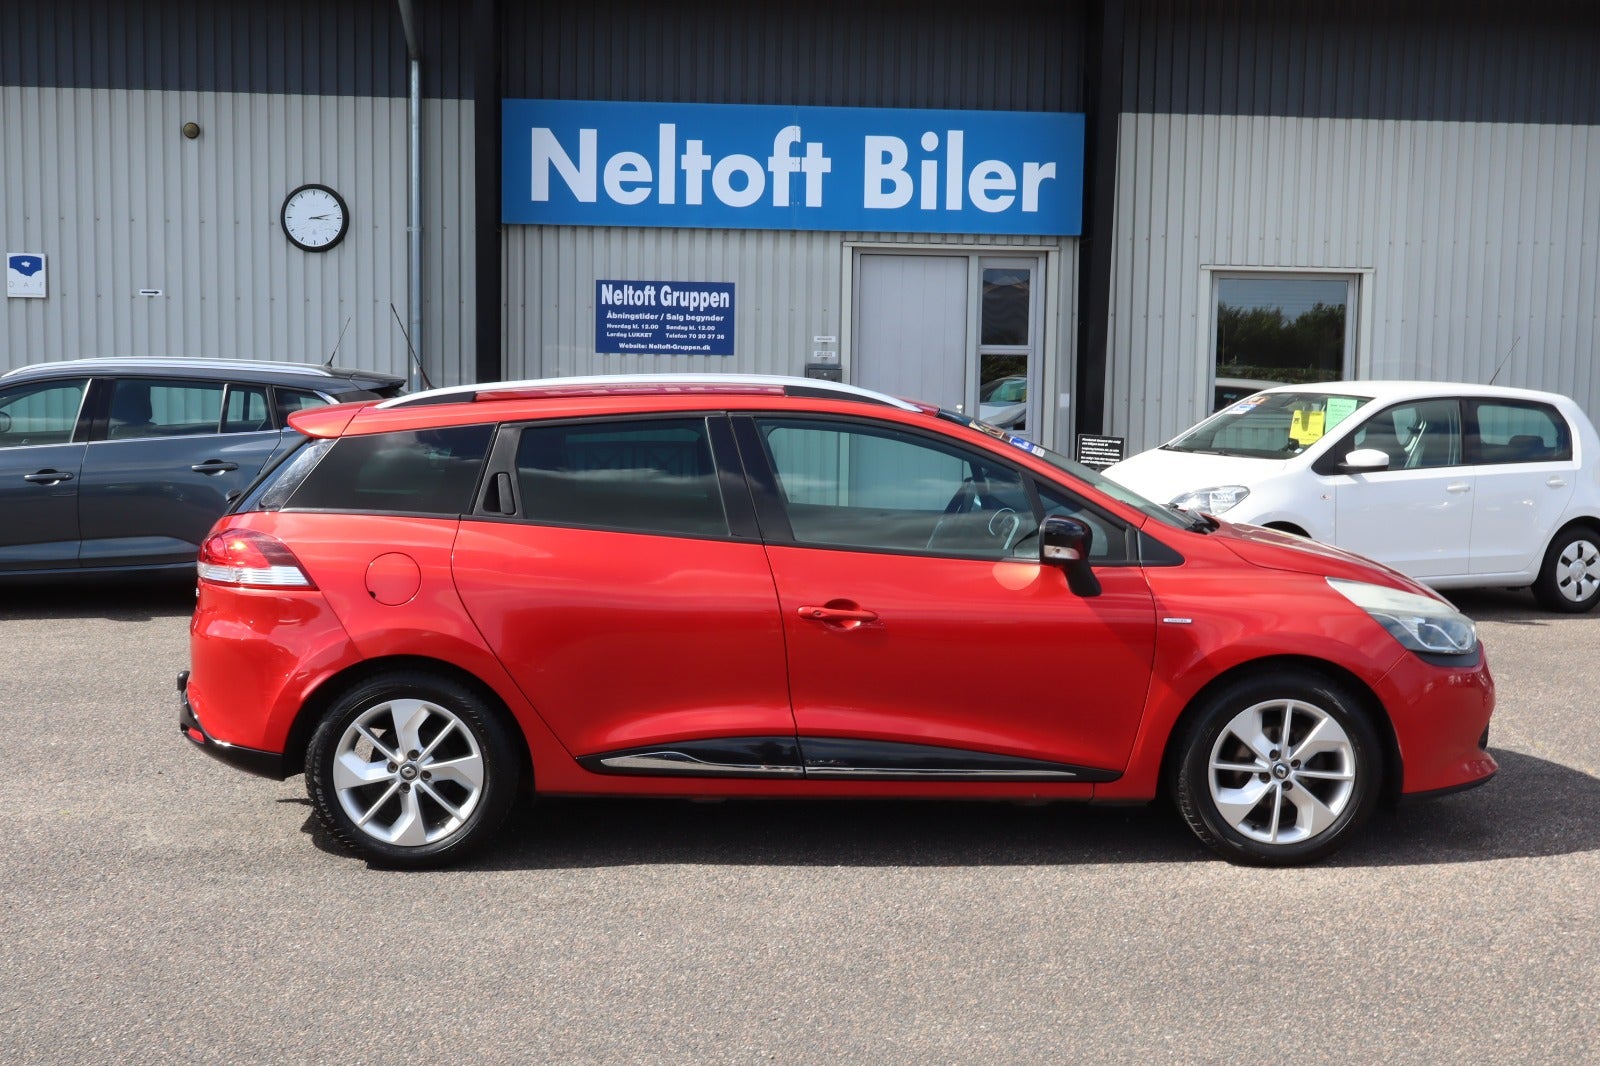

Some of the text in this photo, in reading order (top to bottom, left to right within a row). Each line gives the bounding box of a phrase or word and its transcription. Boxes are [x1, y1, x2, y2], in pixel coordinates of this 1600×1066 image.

[530, 122, 1057, 213] Neltoft Biler
[601, 283, 730, 311] Neltoft Gruppen
[606, 311, 658, 320] Åbningstider
[666, 313, 684, 322] Salg
[685, 314, 724, 322] begynder
